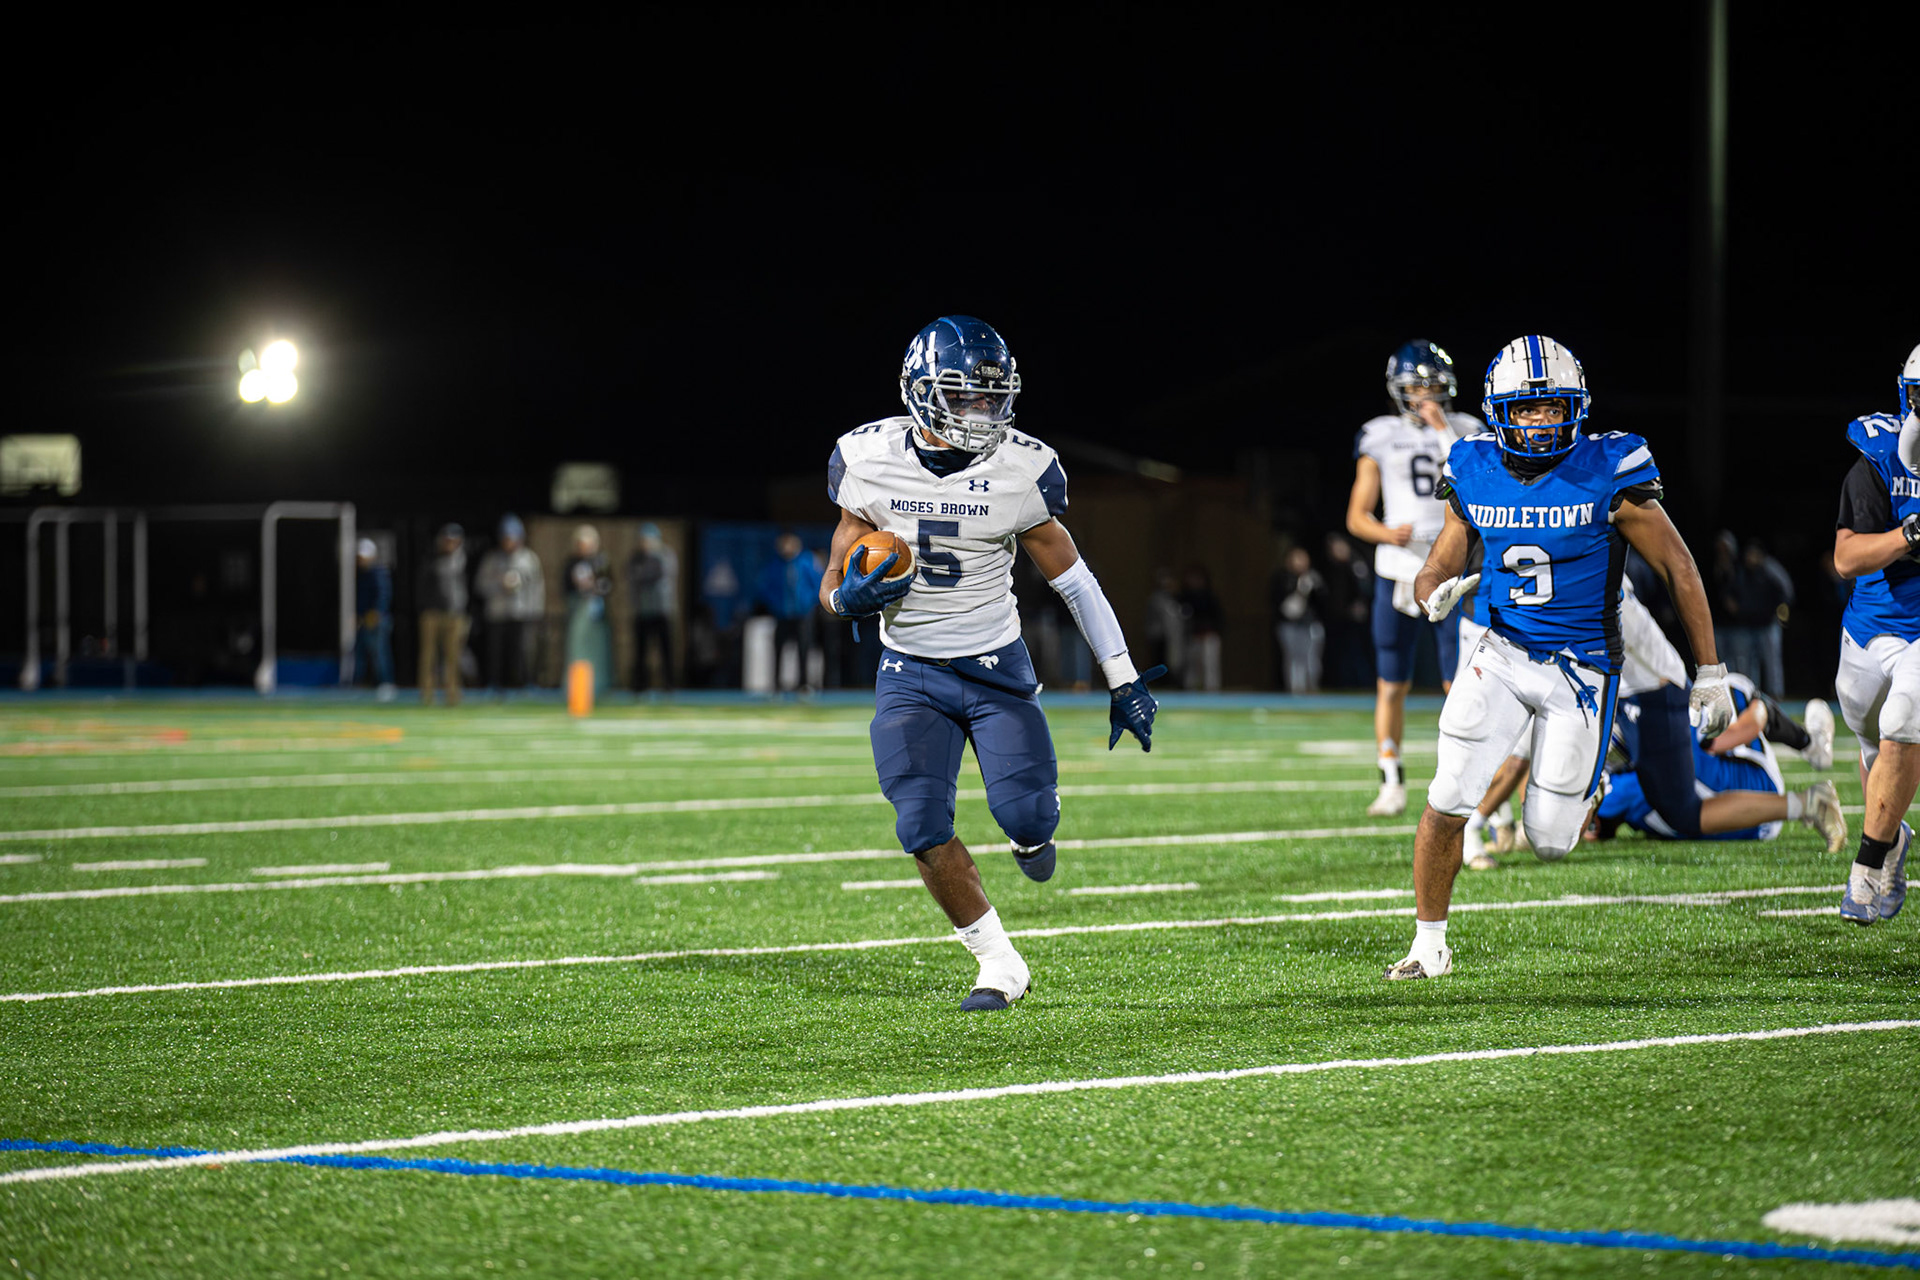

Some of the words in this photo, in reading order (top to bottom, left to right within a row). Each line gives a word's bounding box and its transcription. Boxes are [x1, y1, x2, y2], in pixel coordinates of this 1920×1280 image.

[1411, 454, 1435, 497] 6
[890, 498, 934, 513] MOSES
[940, 502, 989, 516] BROWN
[918, 518, 962, 587] 5
[1502, 544, 1553, 606] 9
